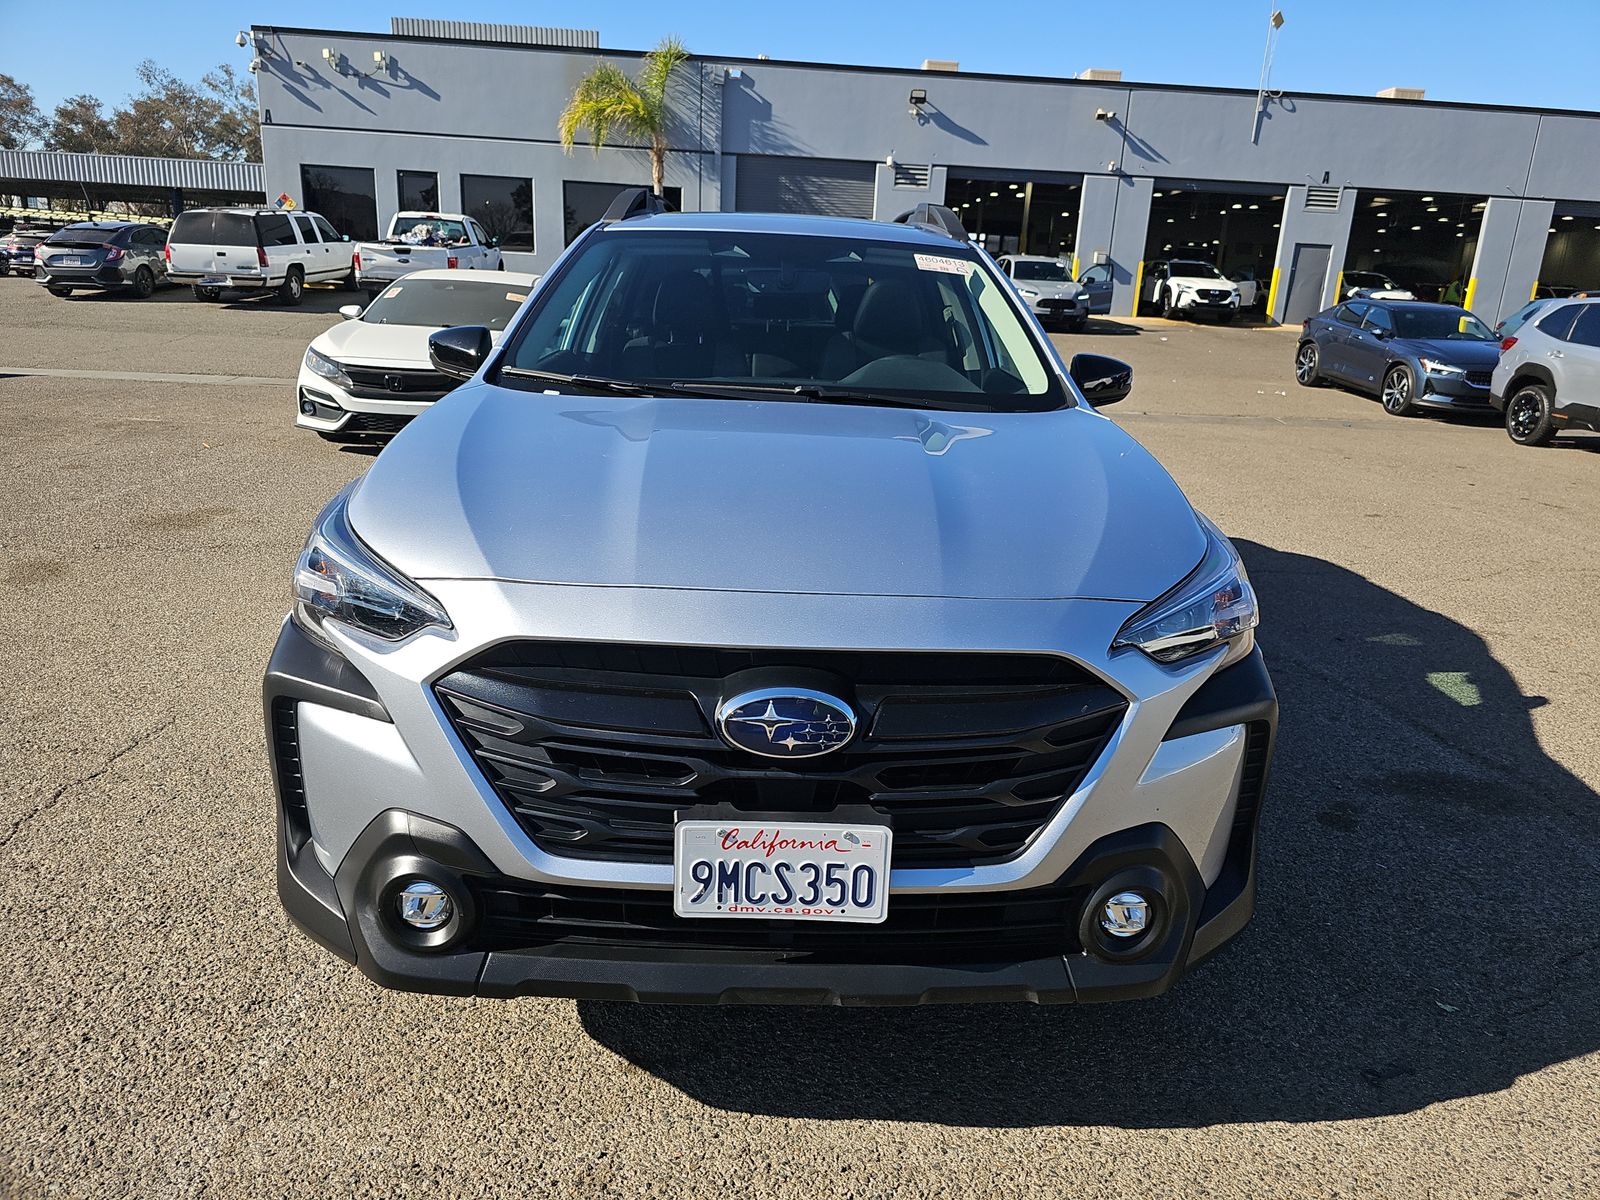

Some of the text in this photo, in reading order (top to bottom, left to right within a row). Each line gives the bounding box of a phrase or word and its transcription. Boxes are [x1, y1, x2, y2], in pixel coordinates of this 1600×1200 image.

[265, 109, 272, 123] A
[1322, 171, 1330, 184] A
[721, 828, 852, 857] California
[690, 860, 875, 908] 9MCS350
[728, 904, 834, 916] dmv.ca.gov
